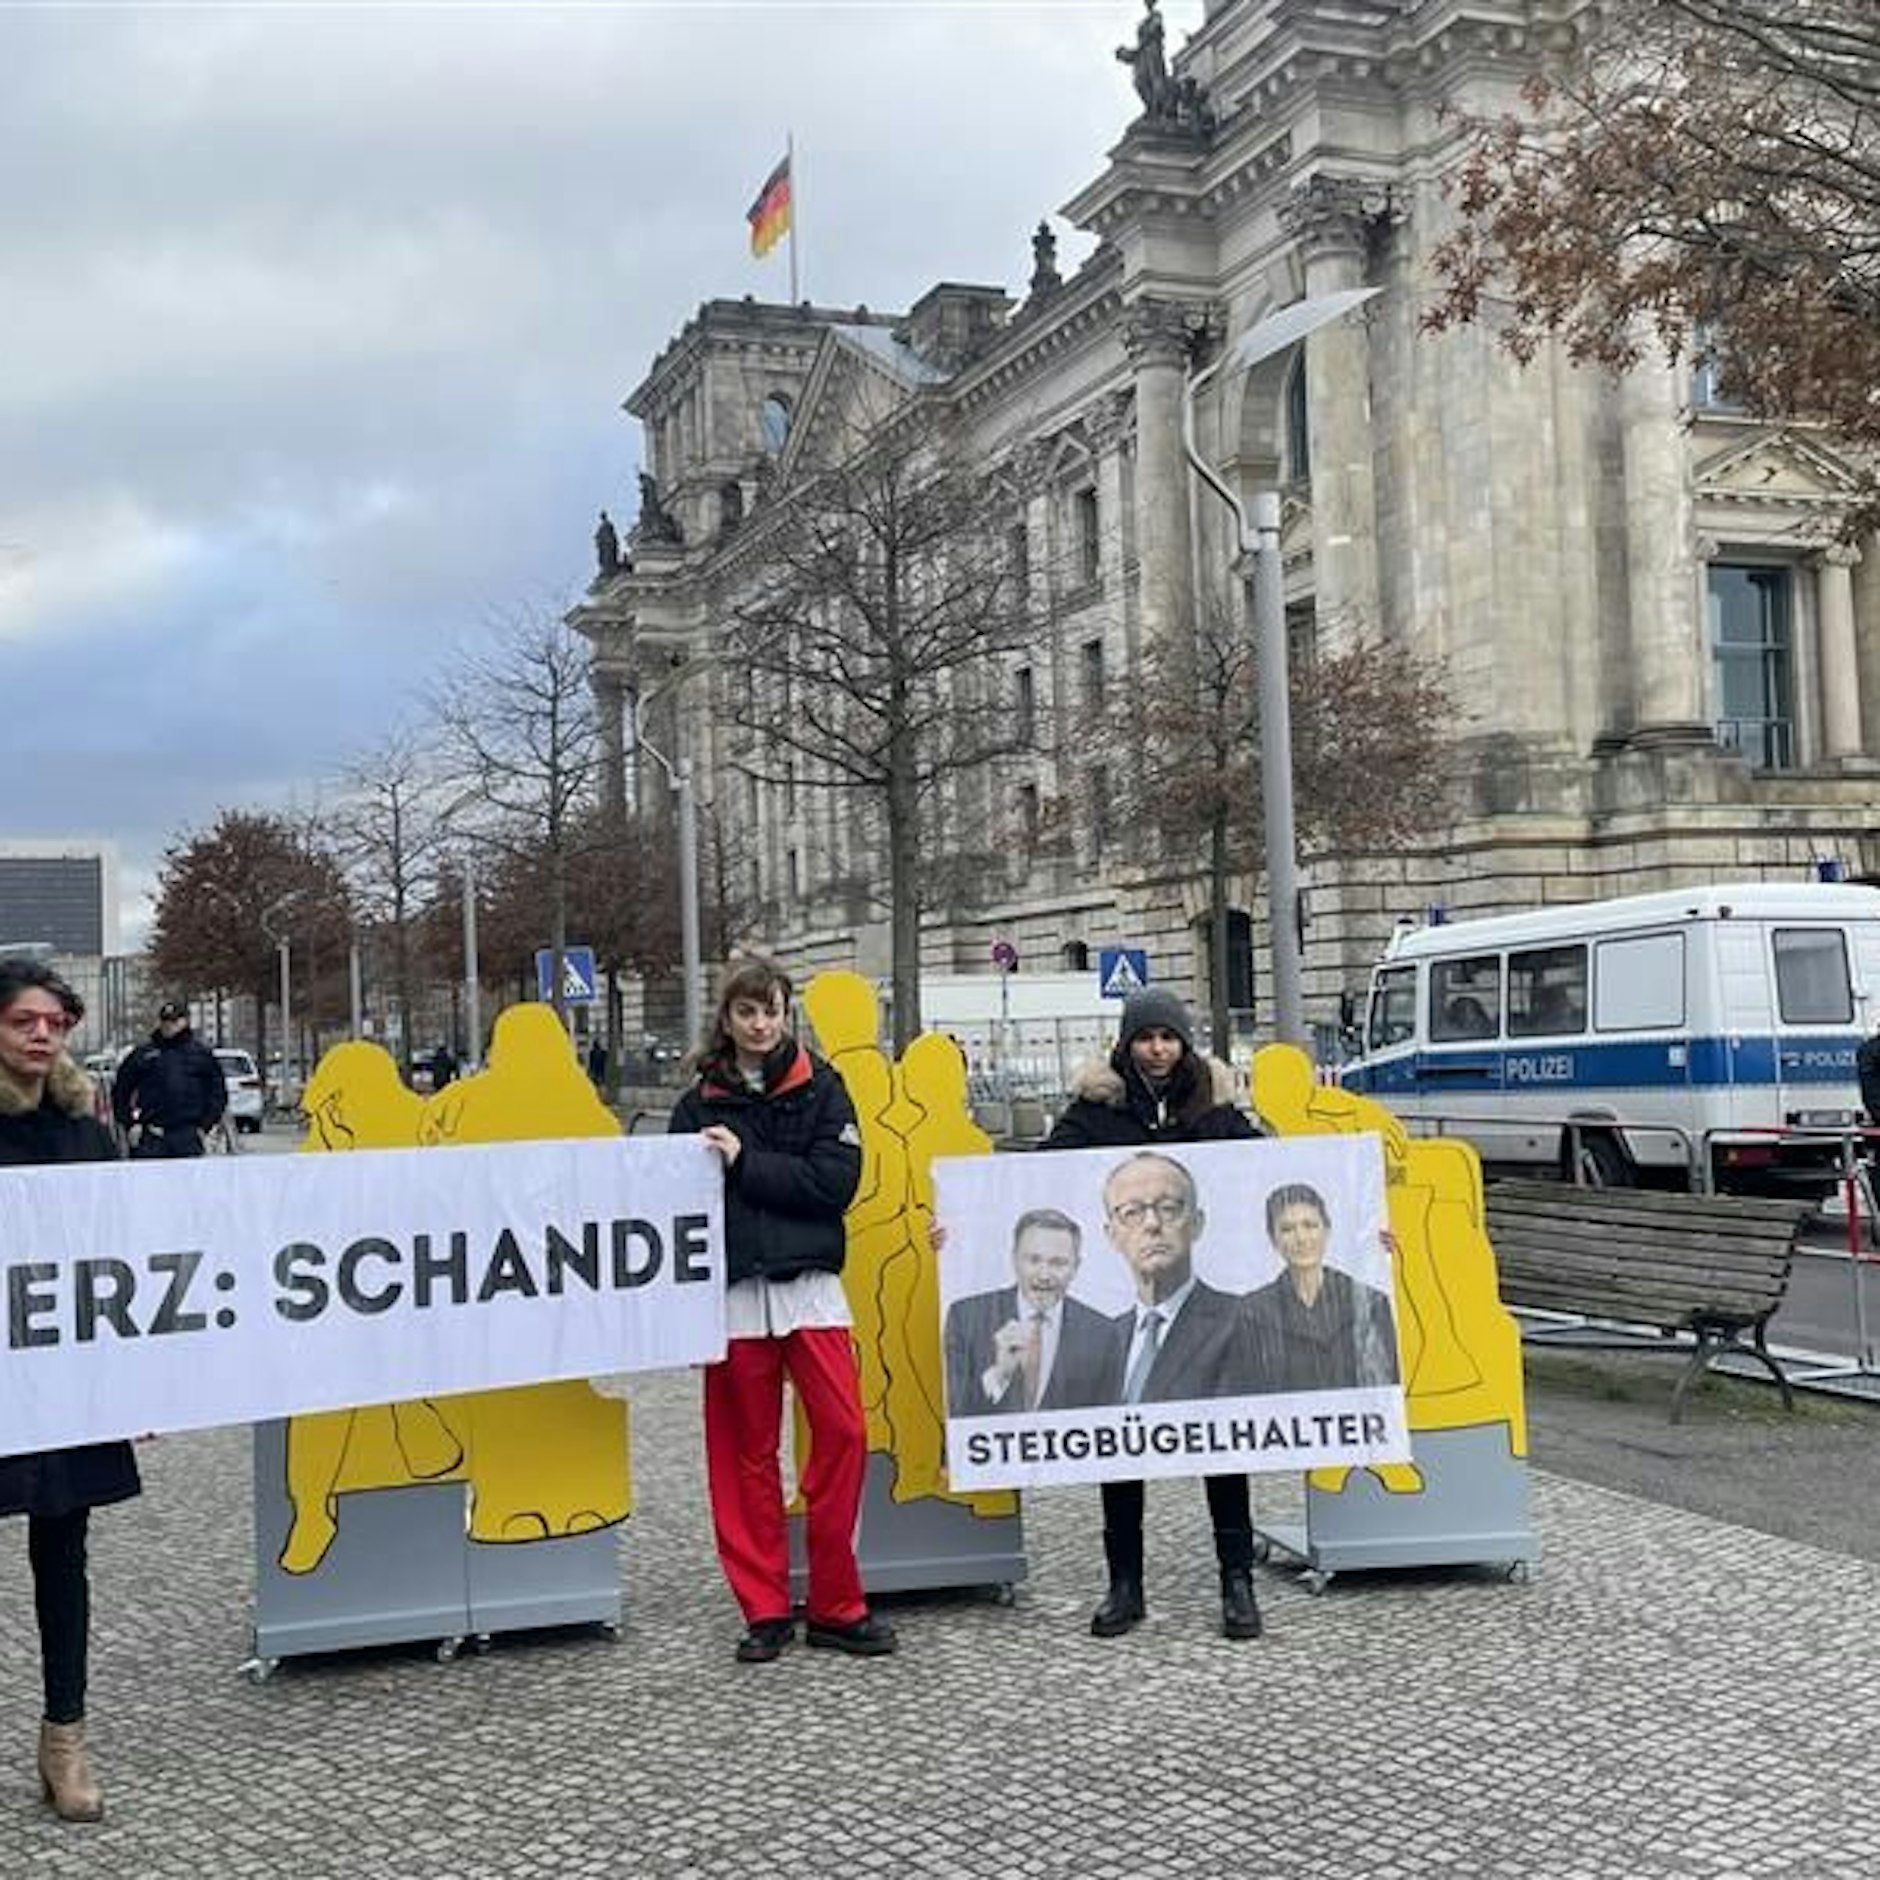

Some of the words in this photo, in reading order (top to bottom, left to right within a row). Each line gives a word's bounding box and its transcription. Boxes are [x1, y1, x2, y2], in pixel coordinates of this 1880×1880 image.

[1506, 1054, 1575, 1082] POLIZEI
[8, 1251, 236, 1350] ERZ:
[273, 1214, 711, 1323] SCHANDE
[968, 1413, 1388, 1466] STEIGBÜGELHALTER
